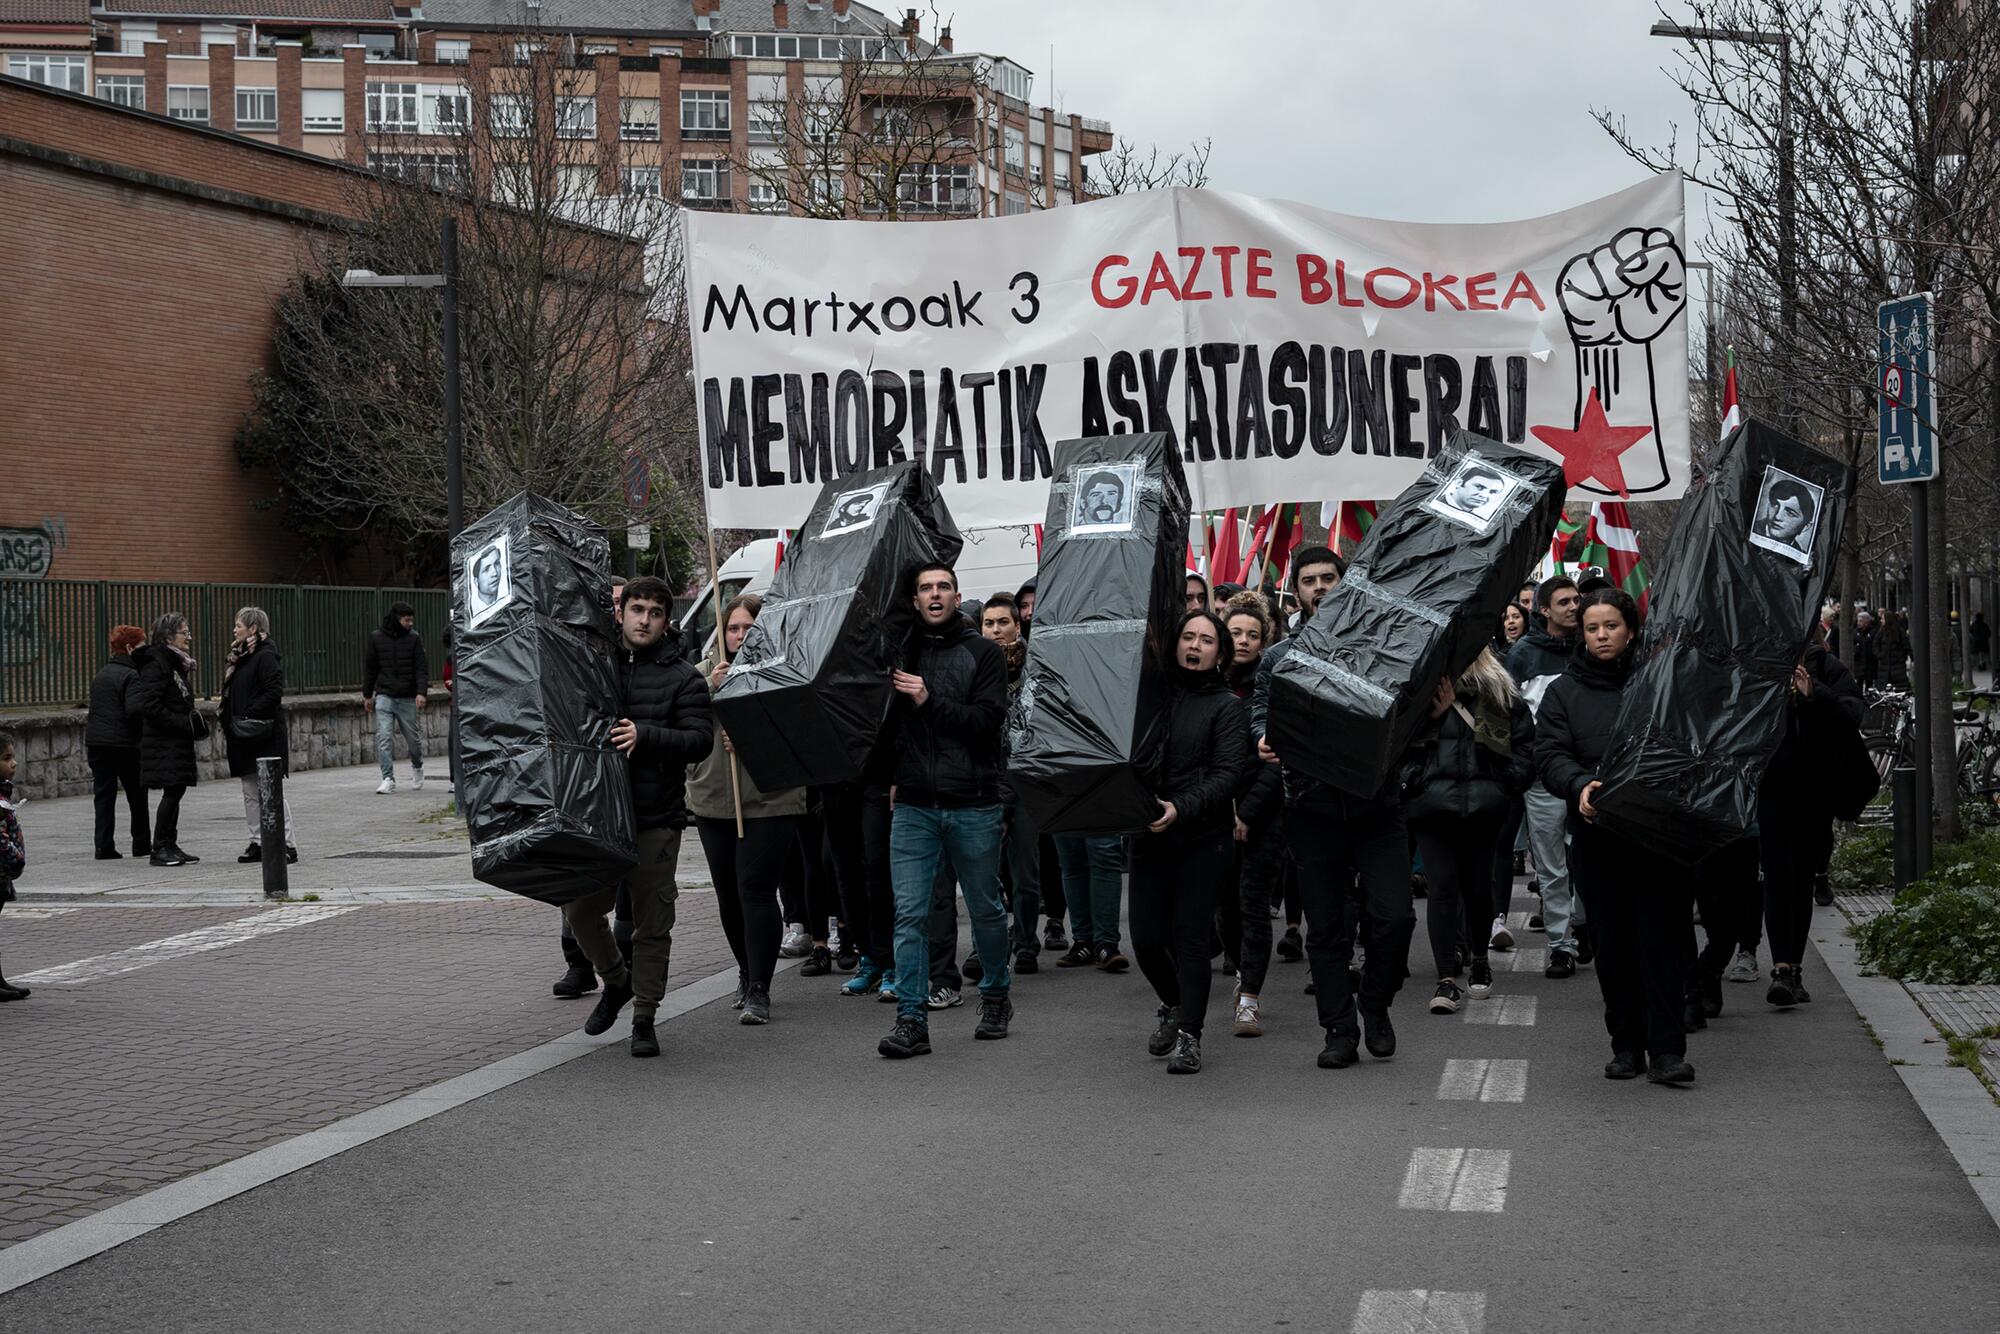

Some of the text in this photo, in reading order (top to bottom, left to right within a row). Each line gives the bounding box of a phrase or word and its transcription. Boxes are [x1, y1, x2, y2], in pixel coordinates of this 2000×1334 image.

[702, 271, 1041, 337] Martxoak 3
[1091, 245, 1547, 313] GAZTE BLOKEA
[1888, 377, 1899, 393] 20
[703, 363, 1053, 489] MEMORIATIK
